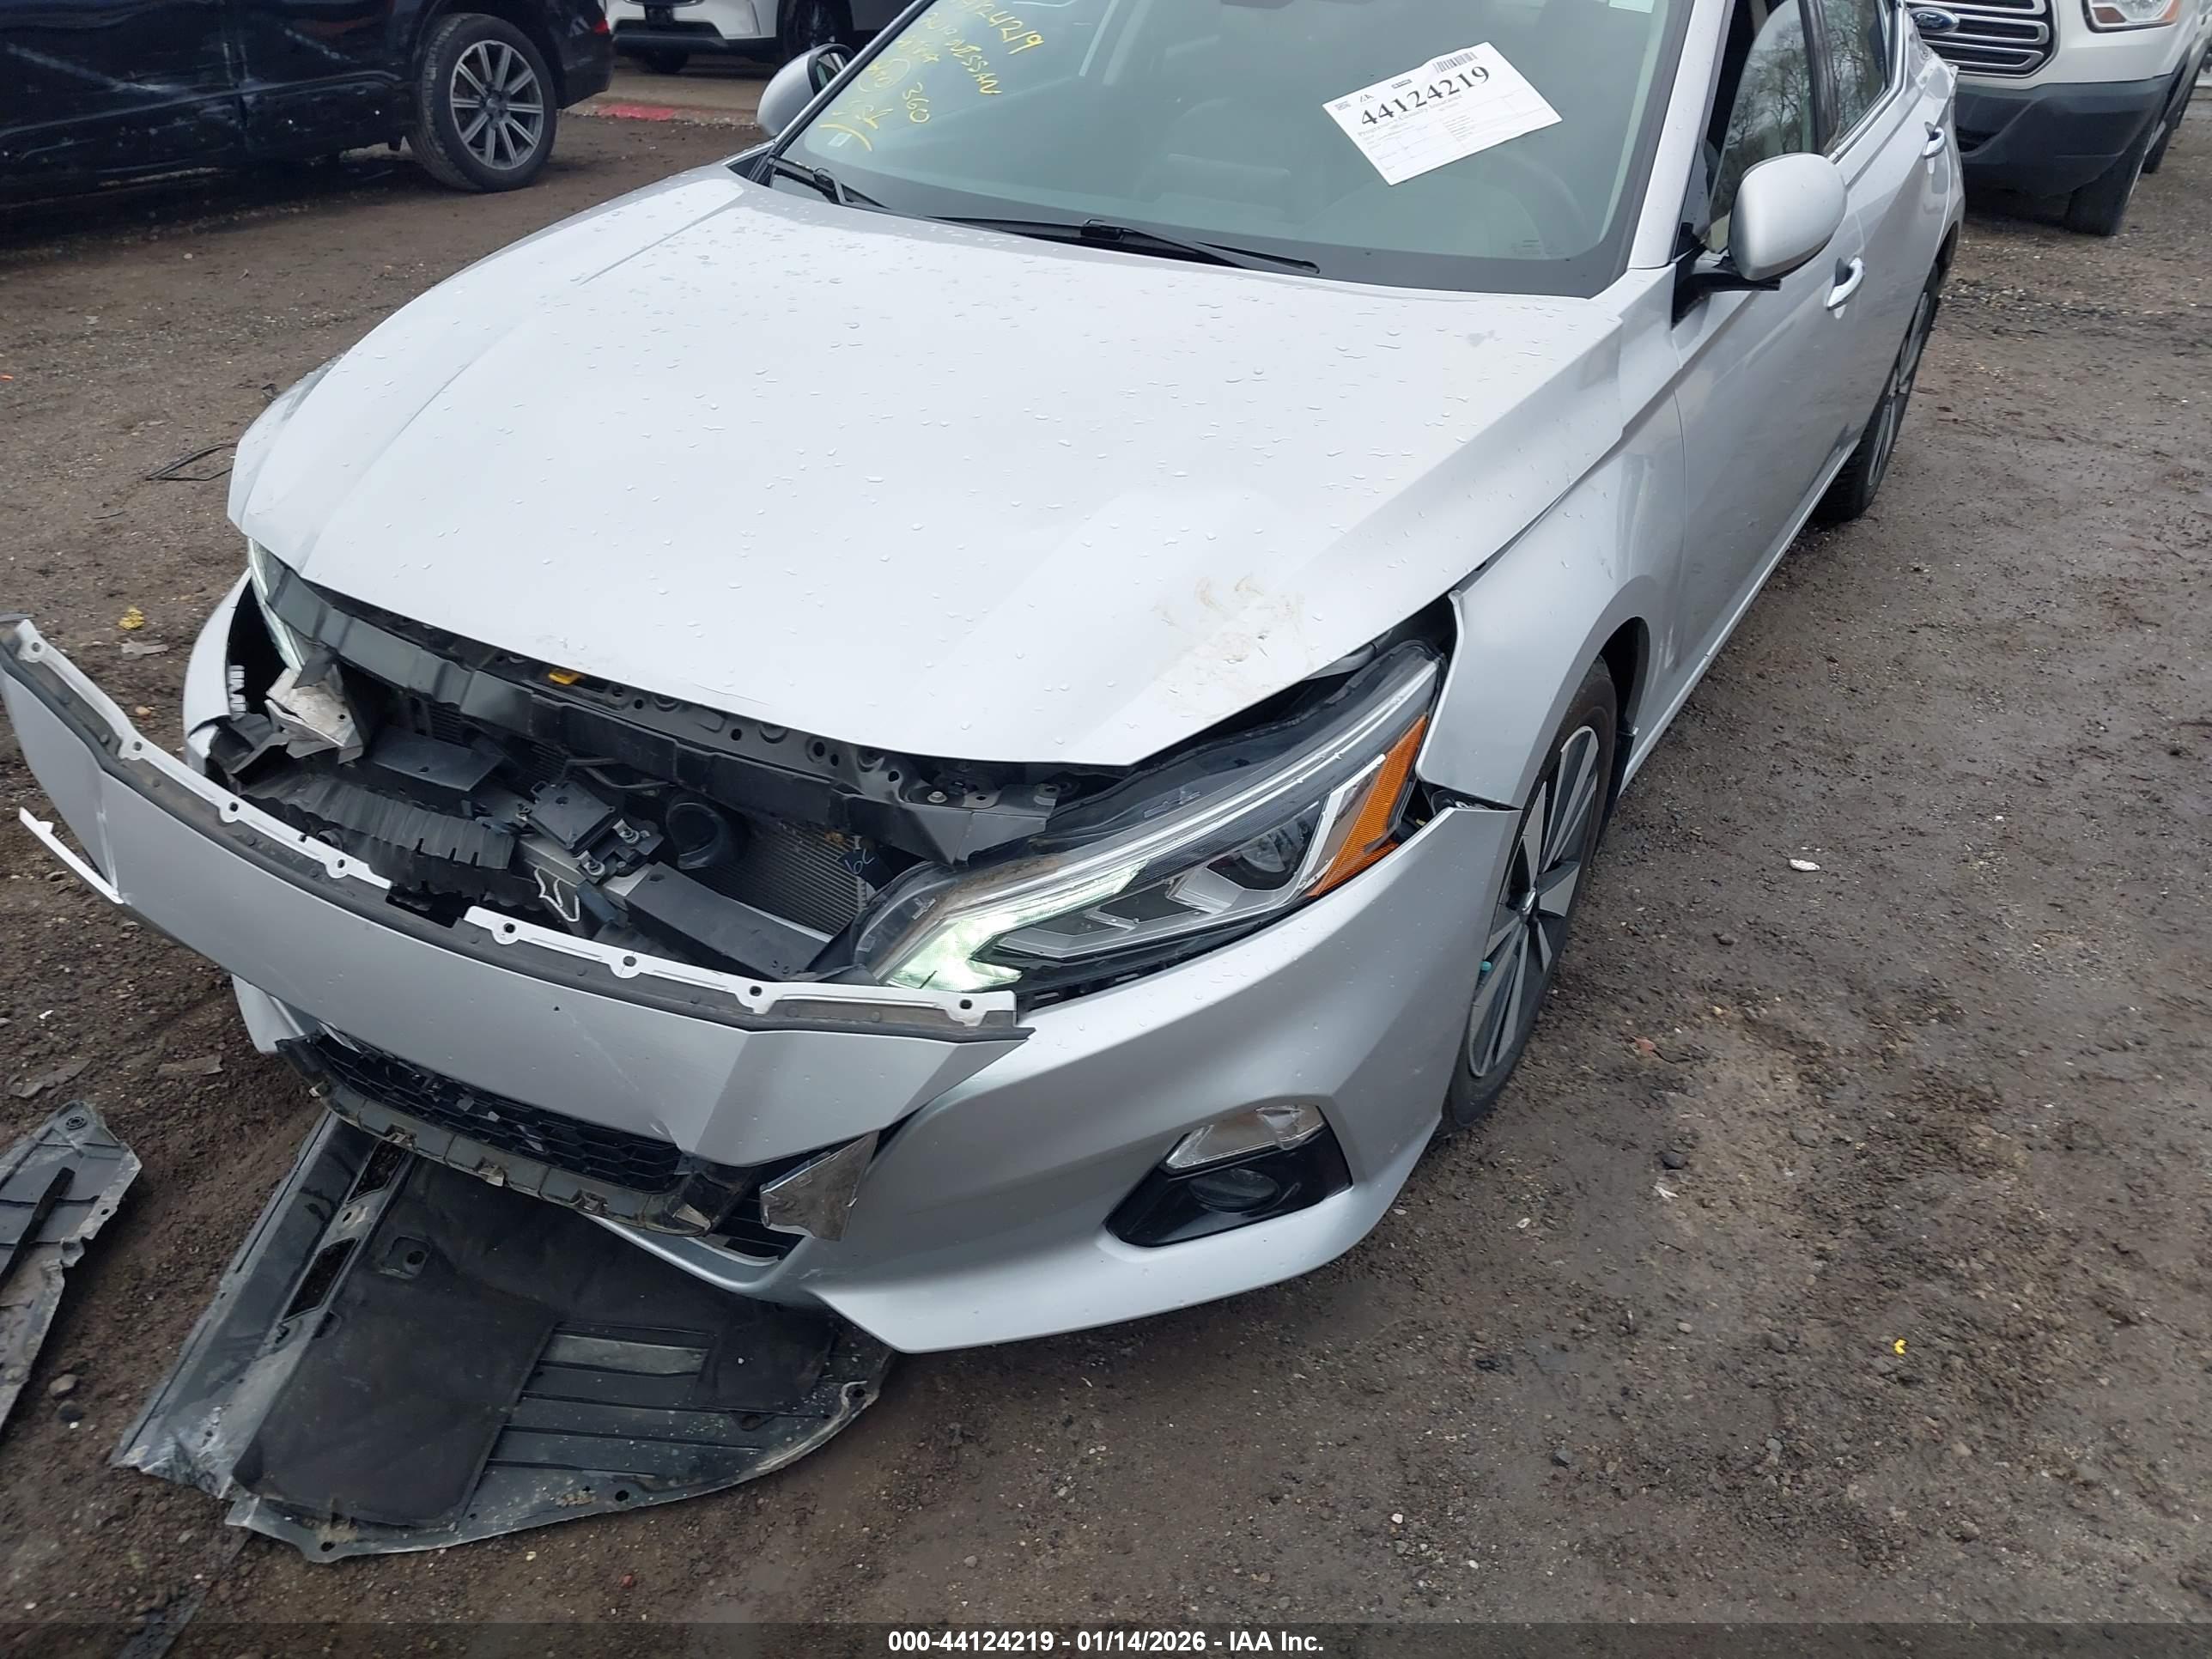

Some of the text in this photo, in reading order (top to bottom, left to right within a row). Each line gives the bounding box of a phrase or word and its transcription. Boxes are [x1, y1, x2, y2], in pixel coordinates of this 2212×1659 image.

[945, 40, 1003, 94] NISSAN
[902, 82, 930, 123] 360
[1361, 65, 1490, 125] 44124219
